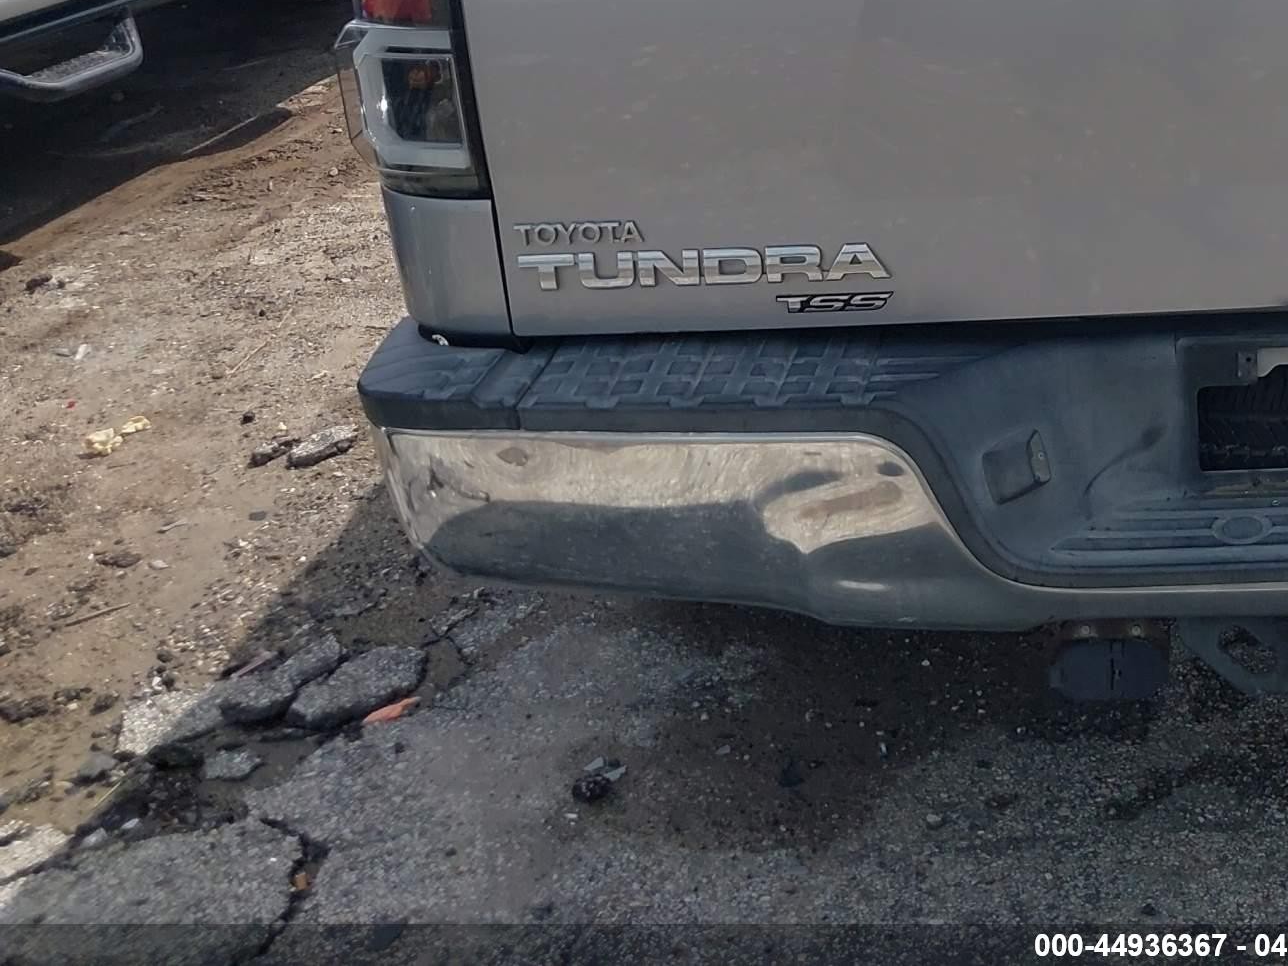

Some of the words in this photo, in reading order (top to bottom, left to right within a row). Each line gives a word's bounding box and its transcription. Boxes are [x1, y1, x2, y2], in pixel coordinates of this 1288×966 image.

[513, 220, 645, 246] TOYOTA
[517, 242, 892, 290] TUNDRA
[776, 291, 894, 314] TSS
